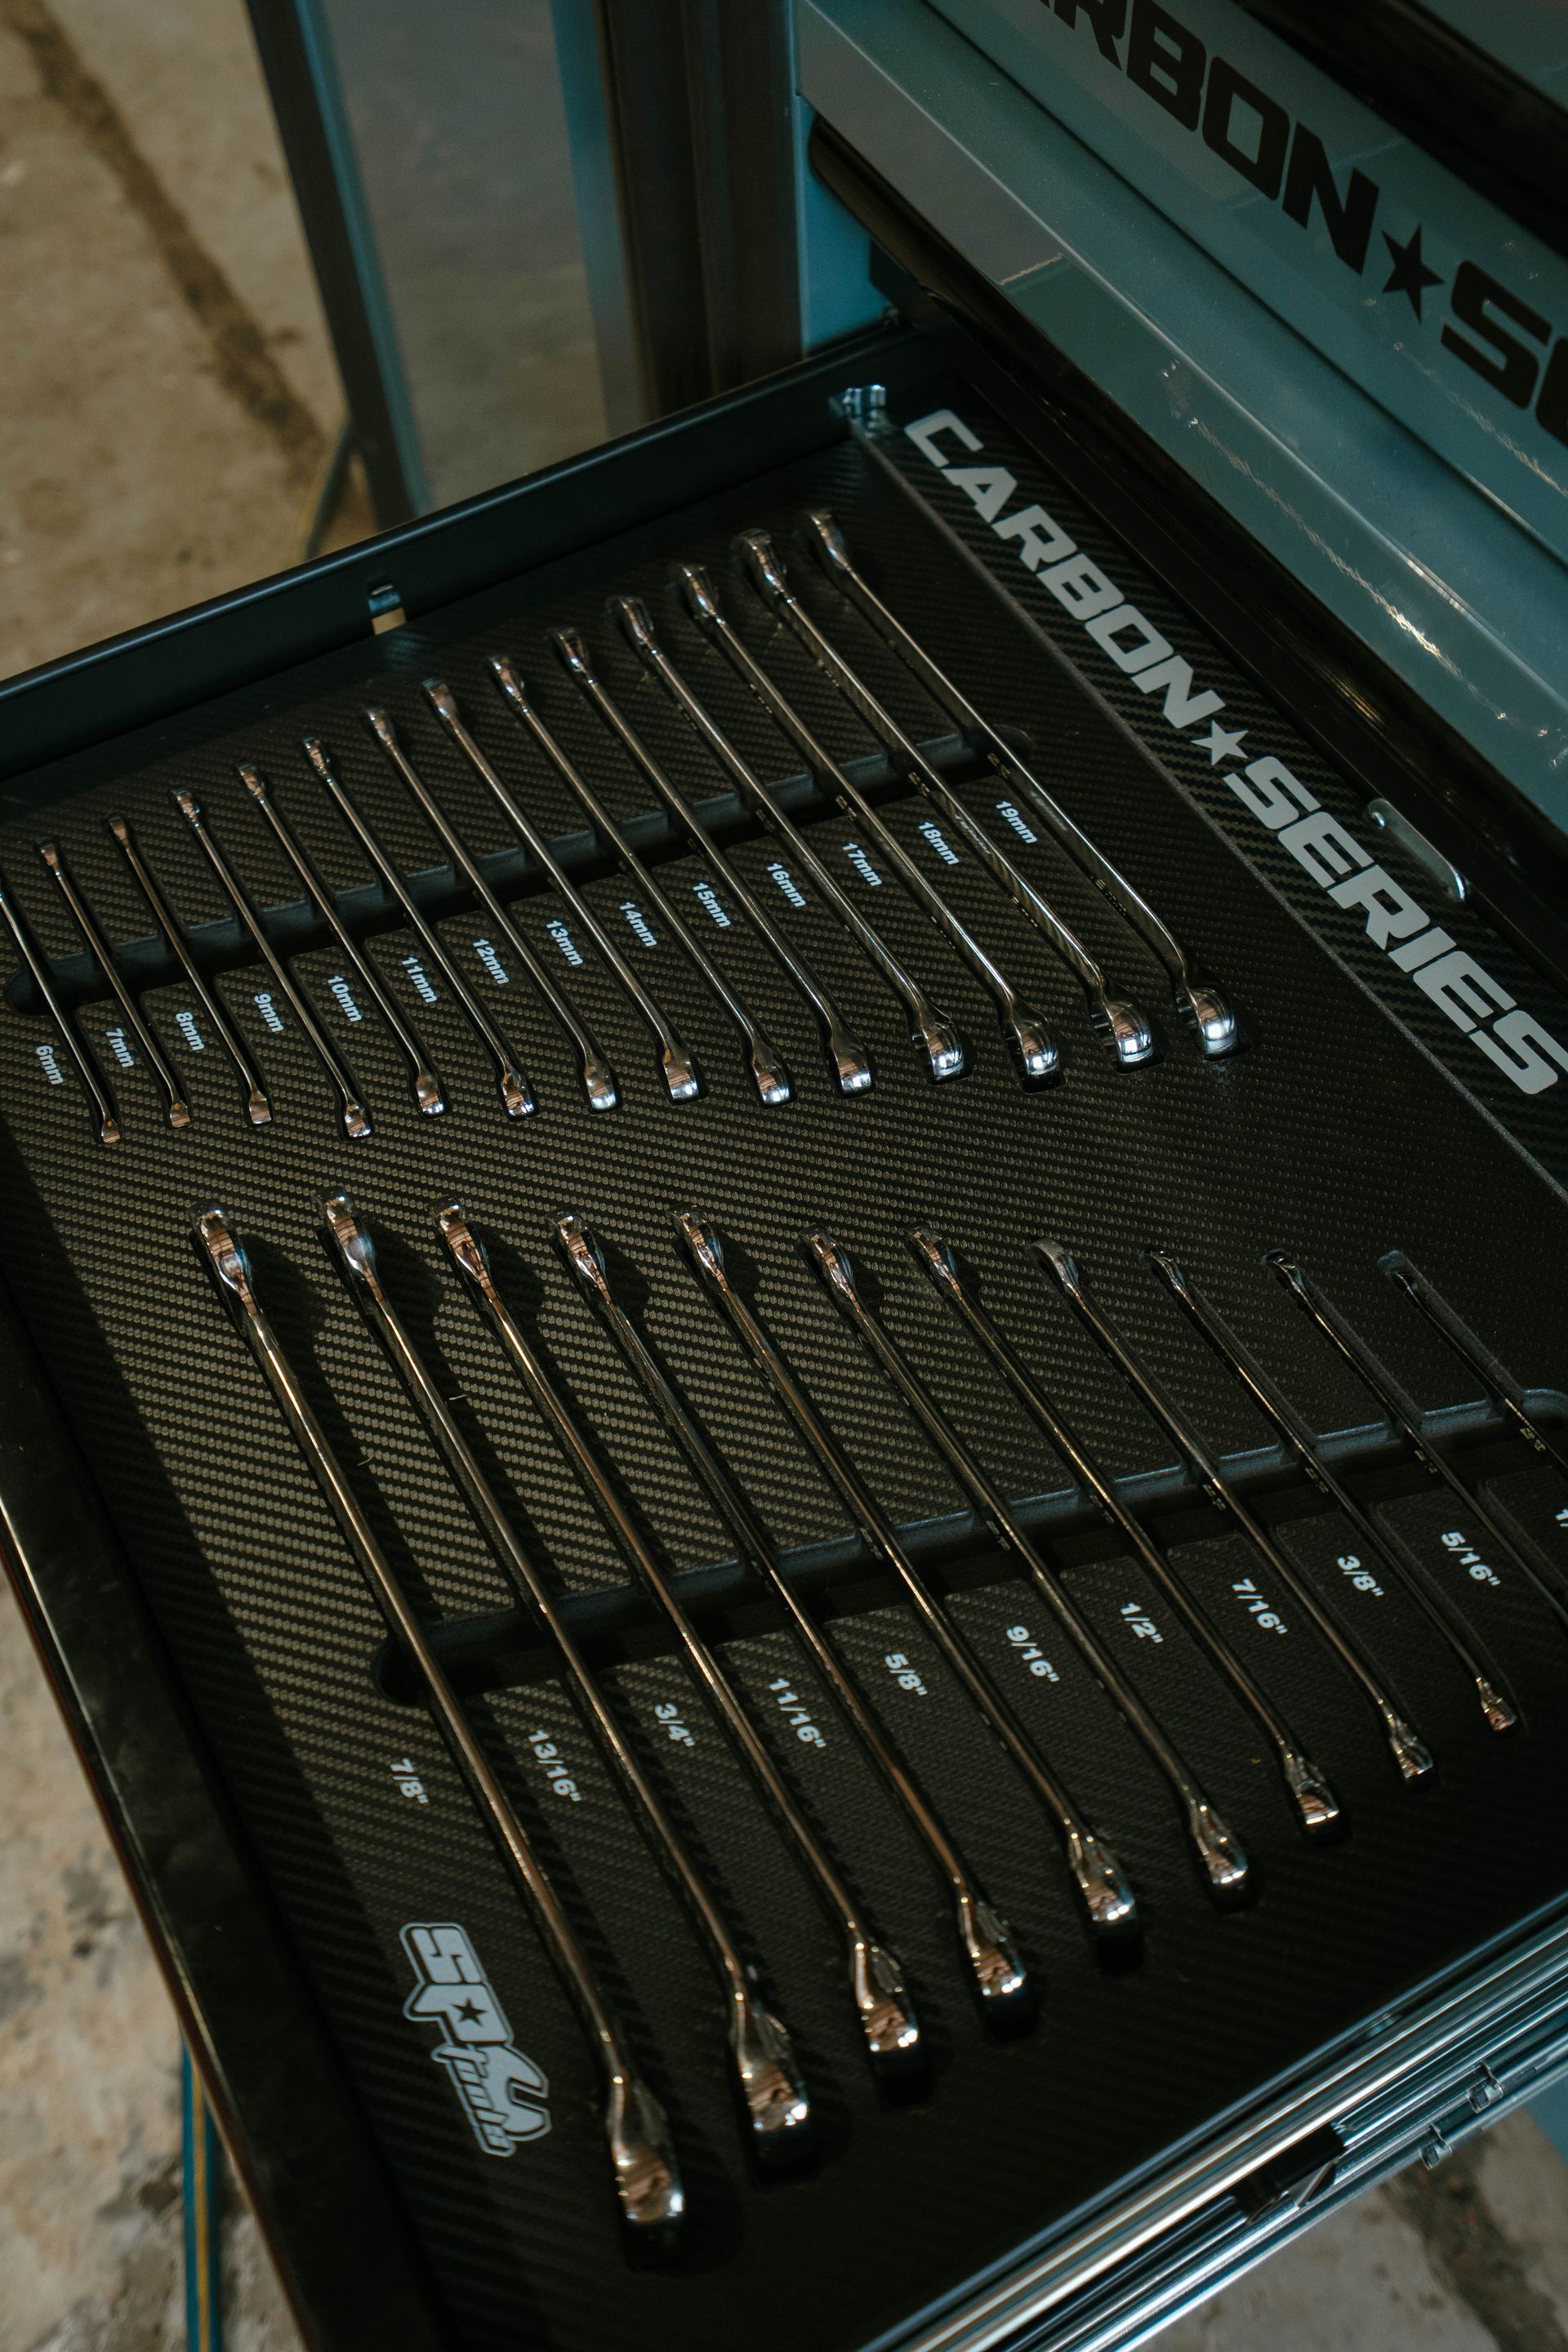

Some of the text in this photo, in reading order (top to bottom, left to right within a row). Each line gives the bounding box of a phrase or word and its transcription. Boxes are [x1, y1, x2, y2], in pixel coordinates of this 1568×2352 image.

[903, 408, 1568, 1095] CARBON SERIES
[917, 821, 960, 866] 18mm
[995, 800, 1039, 844] 19mm
[766, 862, 807, 908] 16mm
[841, 842, 883, 887] 17mm
[618, 901, 658, 948] 14mm
[692, 882, 732, 929] 15mm
[472, 938, 510, 986] 12mm
[545, 920, 584, 967] 13mm
[327, 974, 363, 1023] 10mm
[401, 956, 439, 1004] 11mm
[175, 1011, 206, 1052] 8mm
[253, 992, 285, 1033] 9mm
[35, 1045, 65, 1085] 6mm
[105, 1027, 136, 1069] 7mm
[1336, 1555, 1384, 1597] 3/8"
[1441, 1531, 1501, 1587] 5/16"
[1120, 1602, 1165, 1644] 1/2"
[1232, 1578, 1289, 1635] 7/16"
[884, 1653, 929, 1697] 5/8"
[1005, 1625, 1061, 1683] 9/16"
[654, 1703, 696, 1748] 3/4"
[768, 1677, 827, 1748] 11/16"
[390, 1757, 430, 1805] 7/8"
[528, 1729, 582, 1802] 13/16"
[399, 1922, 514, 2045] SP
